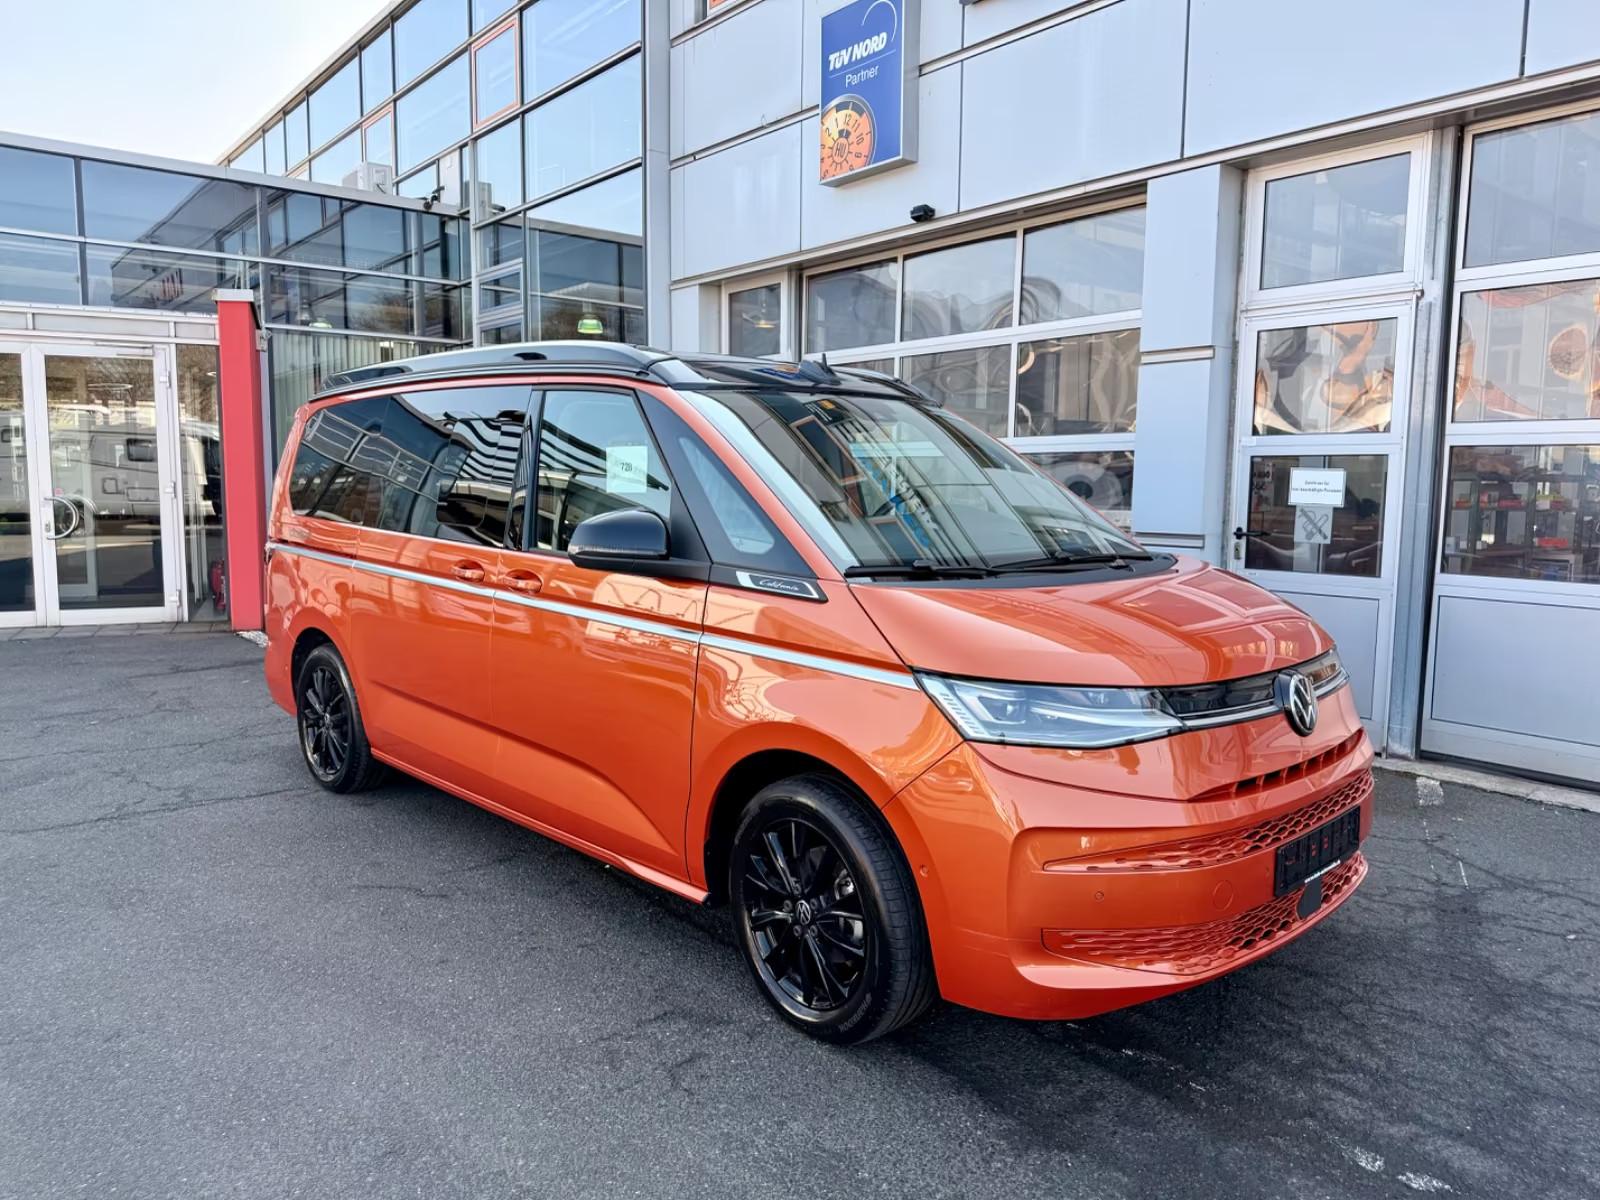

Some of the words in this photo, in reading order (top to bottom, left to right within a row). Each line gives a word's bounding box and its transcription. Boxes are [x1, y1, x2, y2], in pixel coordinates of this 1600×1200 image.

[828, 45, 853, 72] TÜV
[852, 32, 888, 62] NORD
[845, 65, 880, 88] Partner
[759, 579, 800, 591] California
